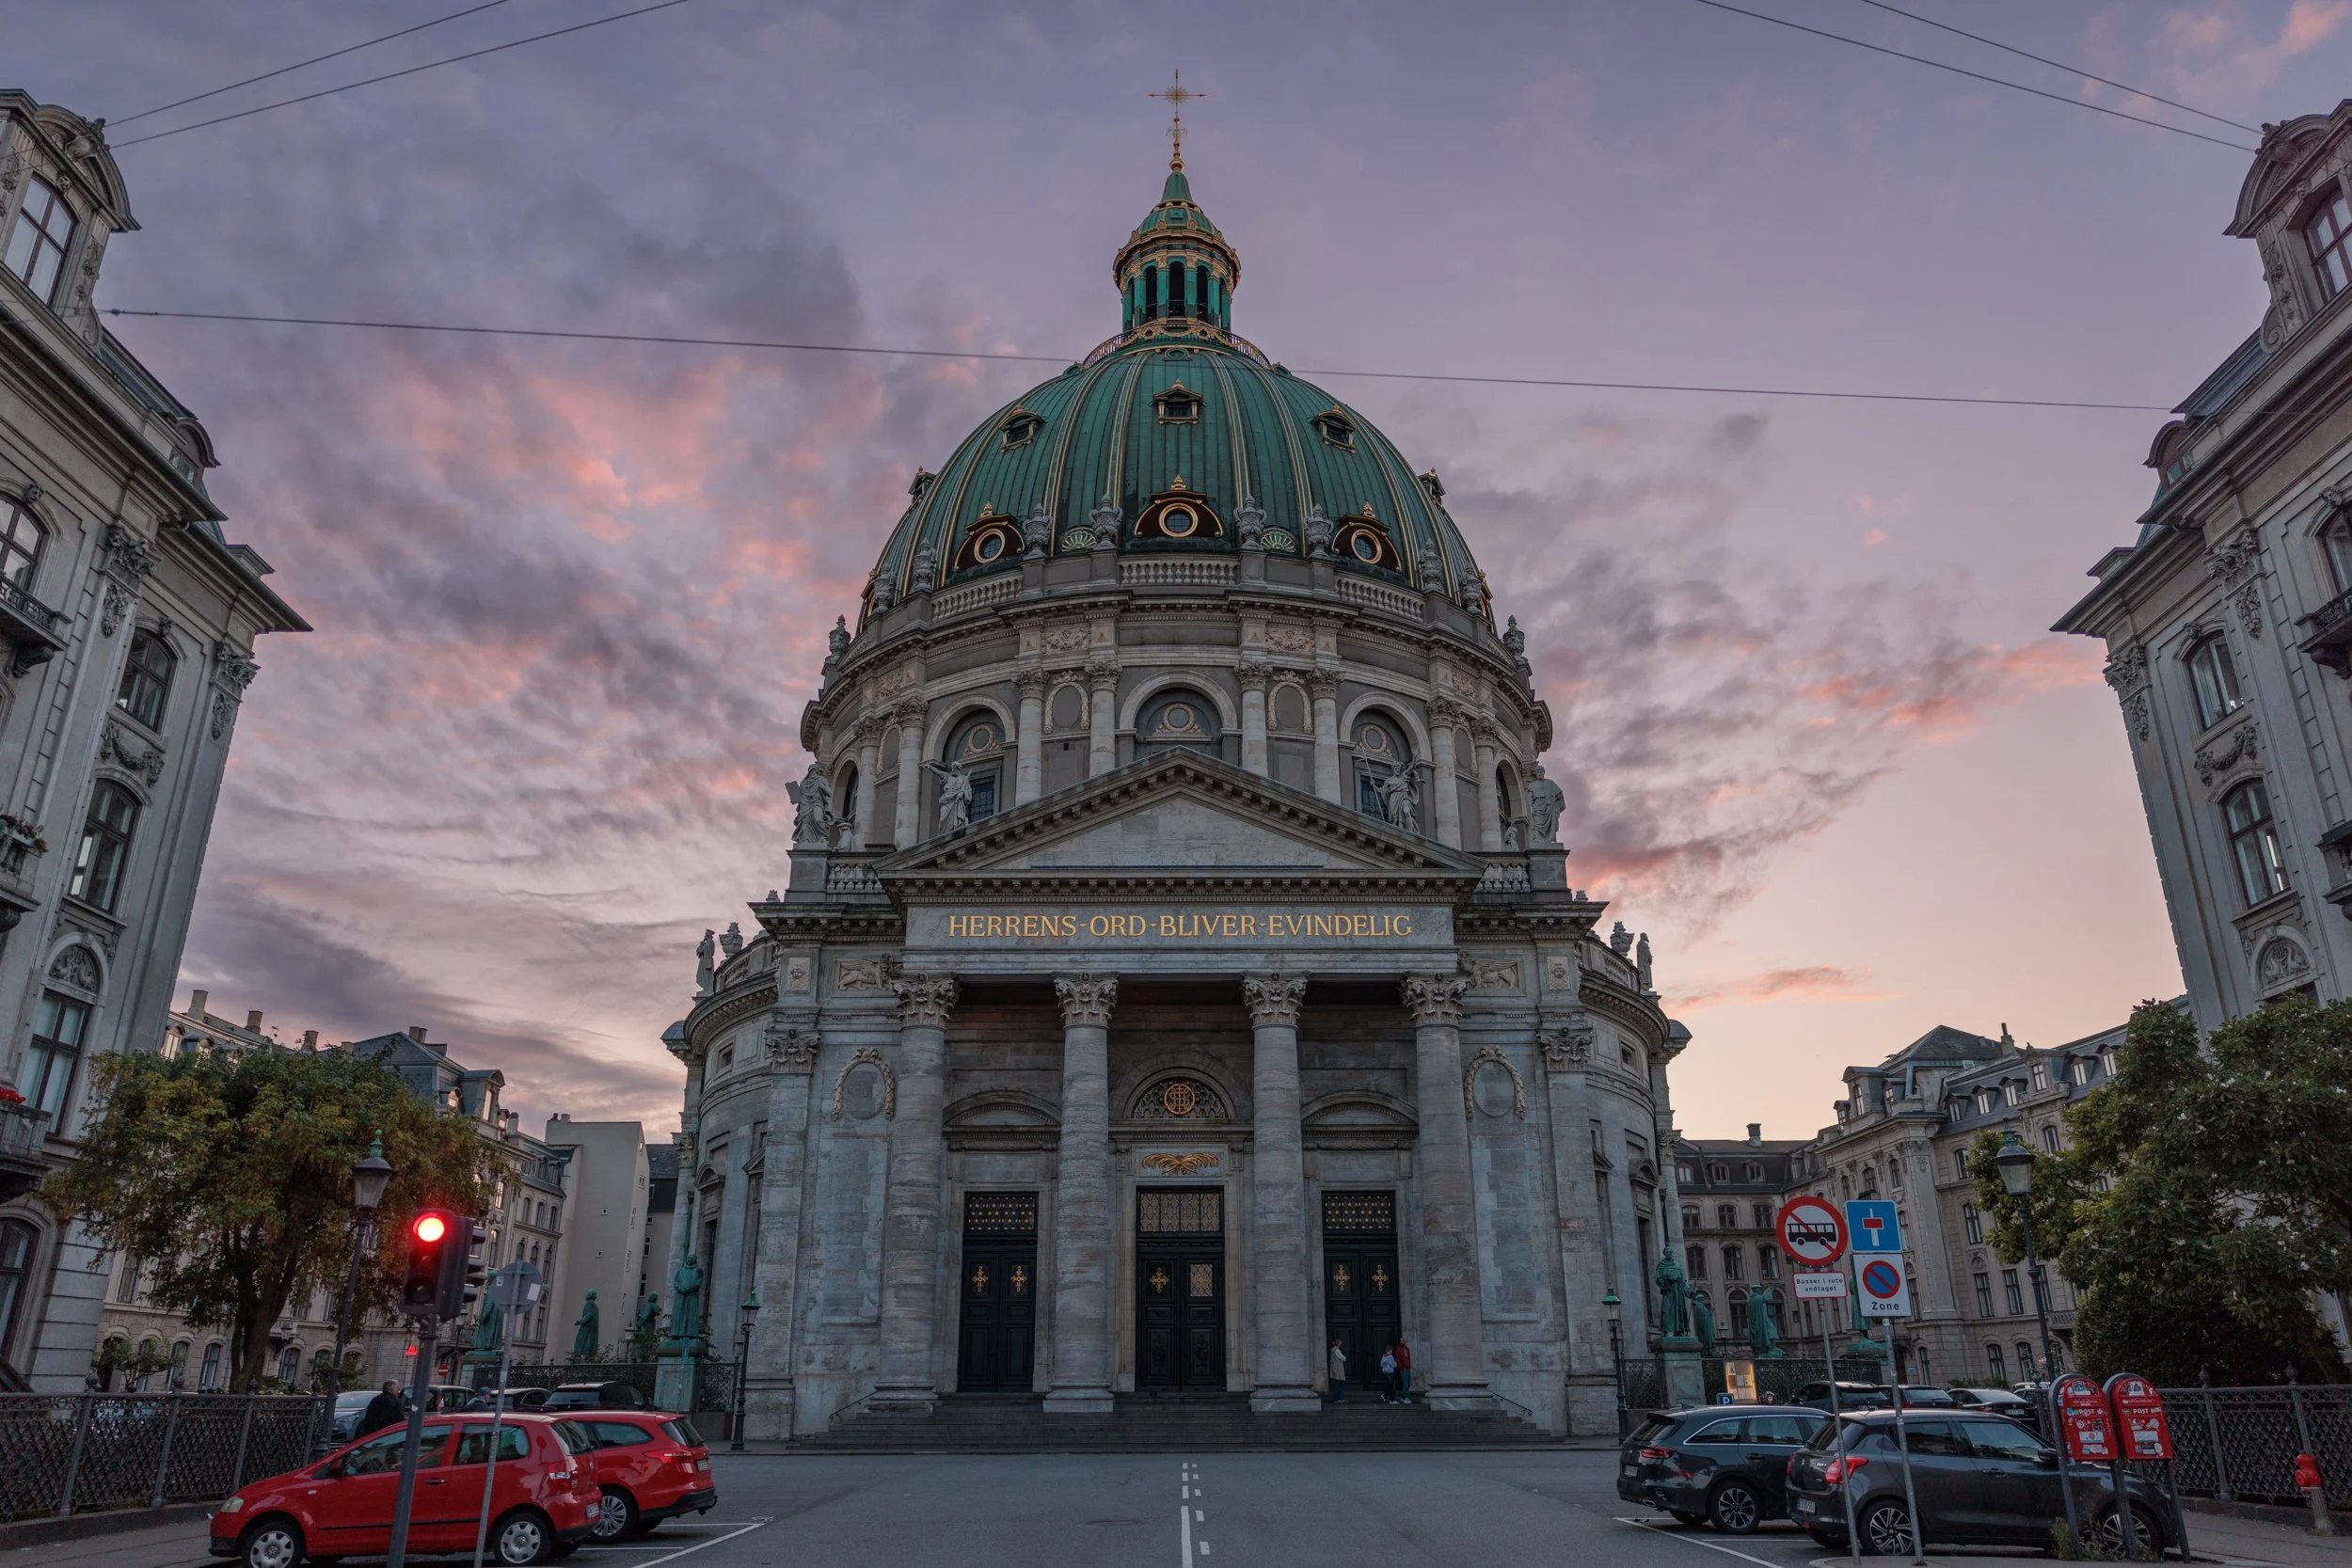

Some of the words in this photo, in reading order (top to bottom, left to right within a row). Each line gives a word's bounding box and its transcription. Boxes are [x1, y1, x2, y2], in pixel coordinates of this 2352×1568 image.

[948, 915, 1077, 937] HERRENS
[1089, 915, 1147, 937] ORD
[1159, 915, 1257, 937] BLIVER
[1267, 915, 1413, 937] EVINDELIG
[1871, 1302, 1899, 1310] Zone
